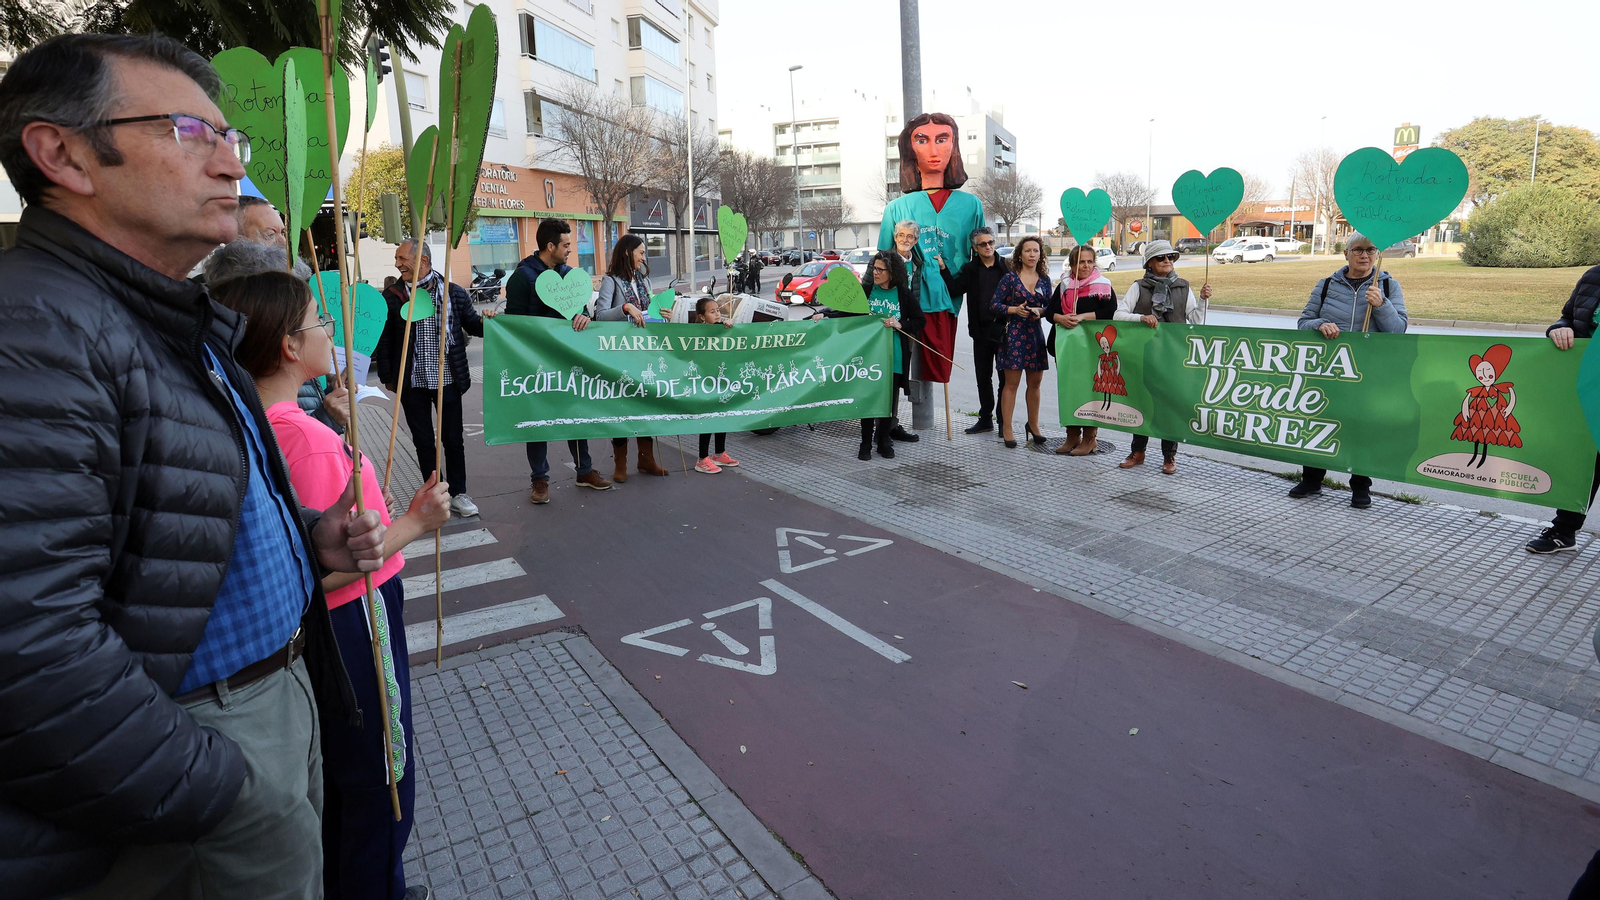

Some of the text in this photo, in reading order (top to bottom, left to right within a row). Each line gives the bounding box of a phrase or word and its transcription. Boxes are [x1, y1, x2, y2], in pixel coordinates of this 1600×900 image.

[480, 167, 518, 182] ORATORIO
[1361, 161, 1452, 185] Rotonda:
[480, 181, 509, 196] DENTAL
[1345, 186, 1413, 203] Escuela
[474, 196, 525, 210] TEBAN FLORES
[1355, 205, 1413, 224] Pública
[597, 333, 807, 351] MAREA VERDE JEREZ
[1186, 337, 1359, 379] MAREA
[500, 370, 578, 397] ESCUELA
[580, 374, 648, 400] PÚBLICA:
[655, 378, 684, 398] DE
[688, 376, 754, 396] TOD@S
[765, 368, 816, 391] PARA
[816, 363, 882, 383] TOD@S
[1204, 367, 1325, 414] Verde
[1117, 412, 1138, 420] ESCUELA
[1191, 406, 1338, 453] JEREZ
[1422, 466, 1475, 480] ENAMORAD@S
[1500, 471, 1539, 483] ESCUELA
[1499, 477, 1537, 490] PÚBLICA
[383, 653, 392, 671] SIK
